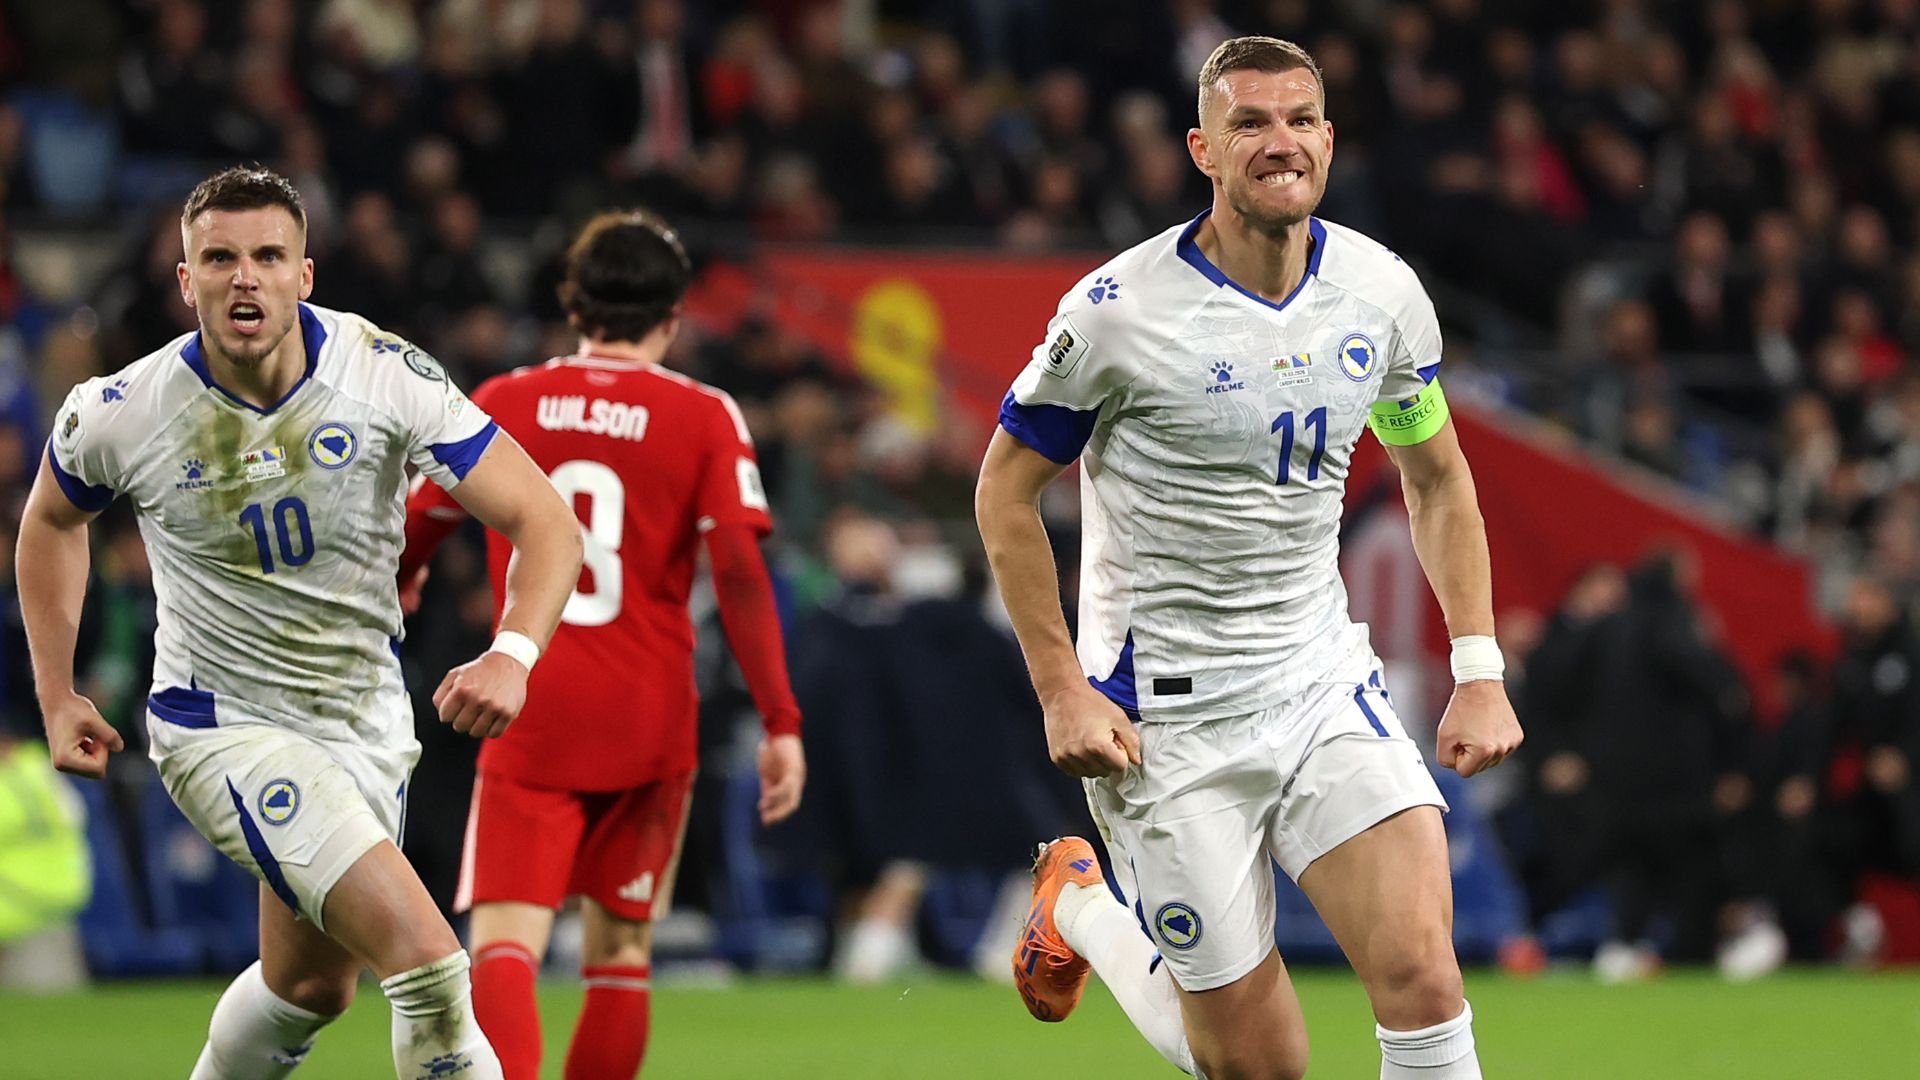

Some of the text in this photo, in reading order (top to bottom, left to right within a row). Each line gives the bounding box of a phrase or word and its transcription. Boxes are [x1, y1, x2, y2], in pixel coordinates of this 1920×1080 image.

[1205, 382, 1245, 395] KELME
[535, 394, 650, 442] WILSON
[1389, 398, 1436, 428] RESPECT
[1271, 406, 1327, 486] 11
[176, 479, 214, 489] KELME
[239, 496, 315, 574] 10
[548, 459, 625, 627] 8
